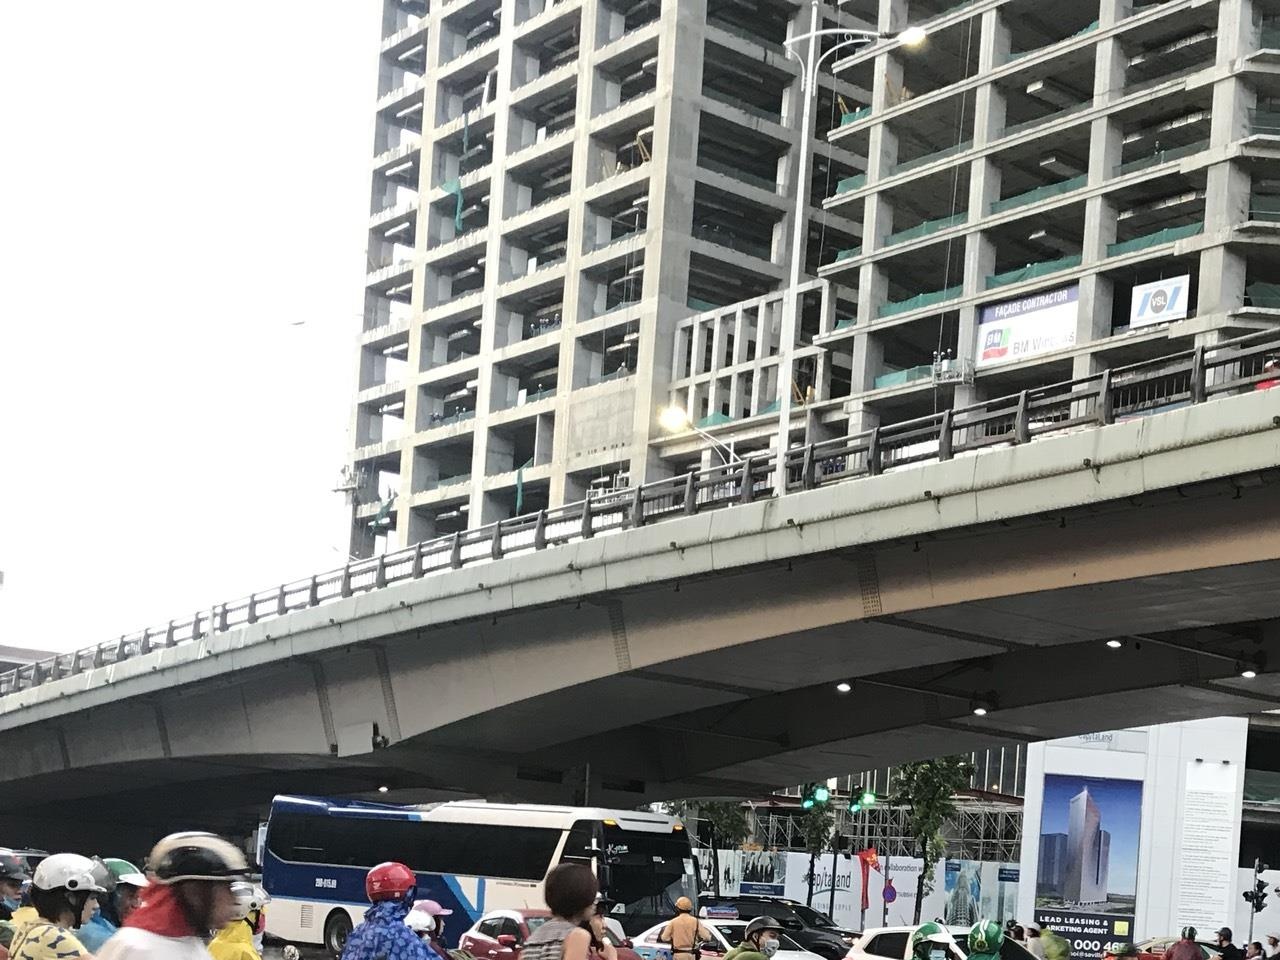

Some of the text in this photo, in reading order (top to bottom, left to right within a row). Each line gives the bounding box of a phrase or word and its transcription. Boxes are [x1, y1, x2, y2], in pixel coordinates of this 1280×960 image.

[1022, 290, 1068, 311] CONTRACTOR
[1151, 296, 1167, 307] VSL
[1040, 915, 1062, 923] LEAD
[1074, 940, 1100, 951] 000
